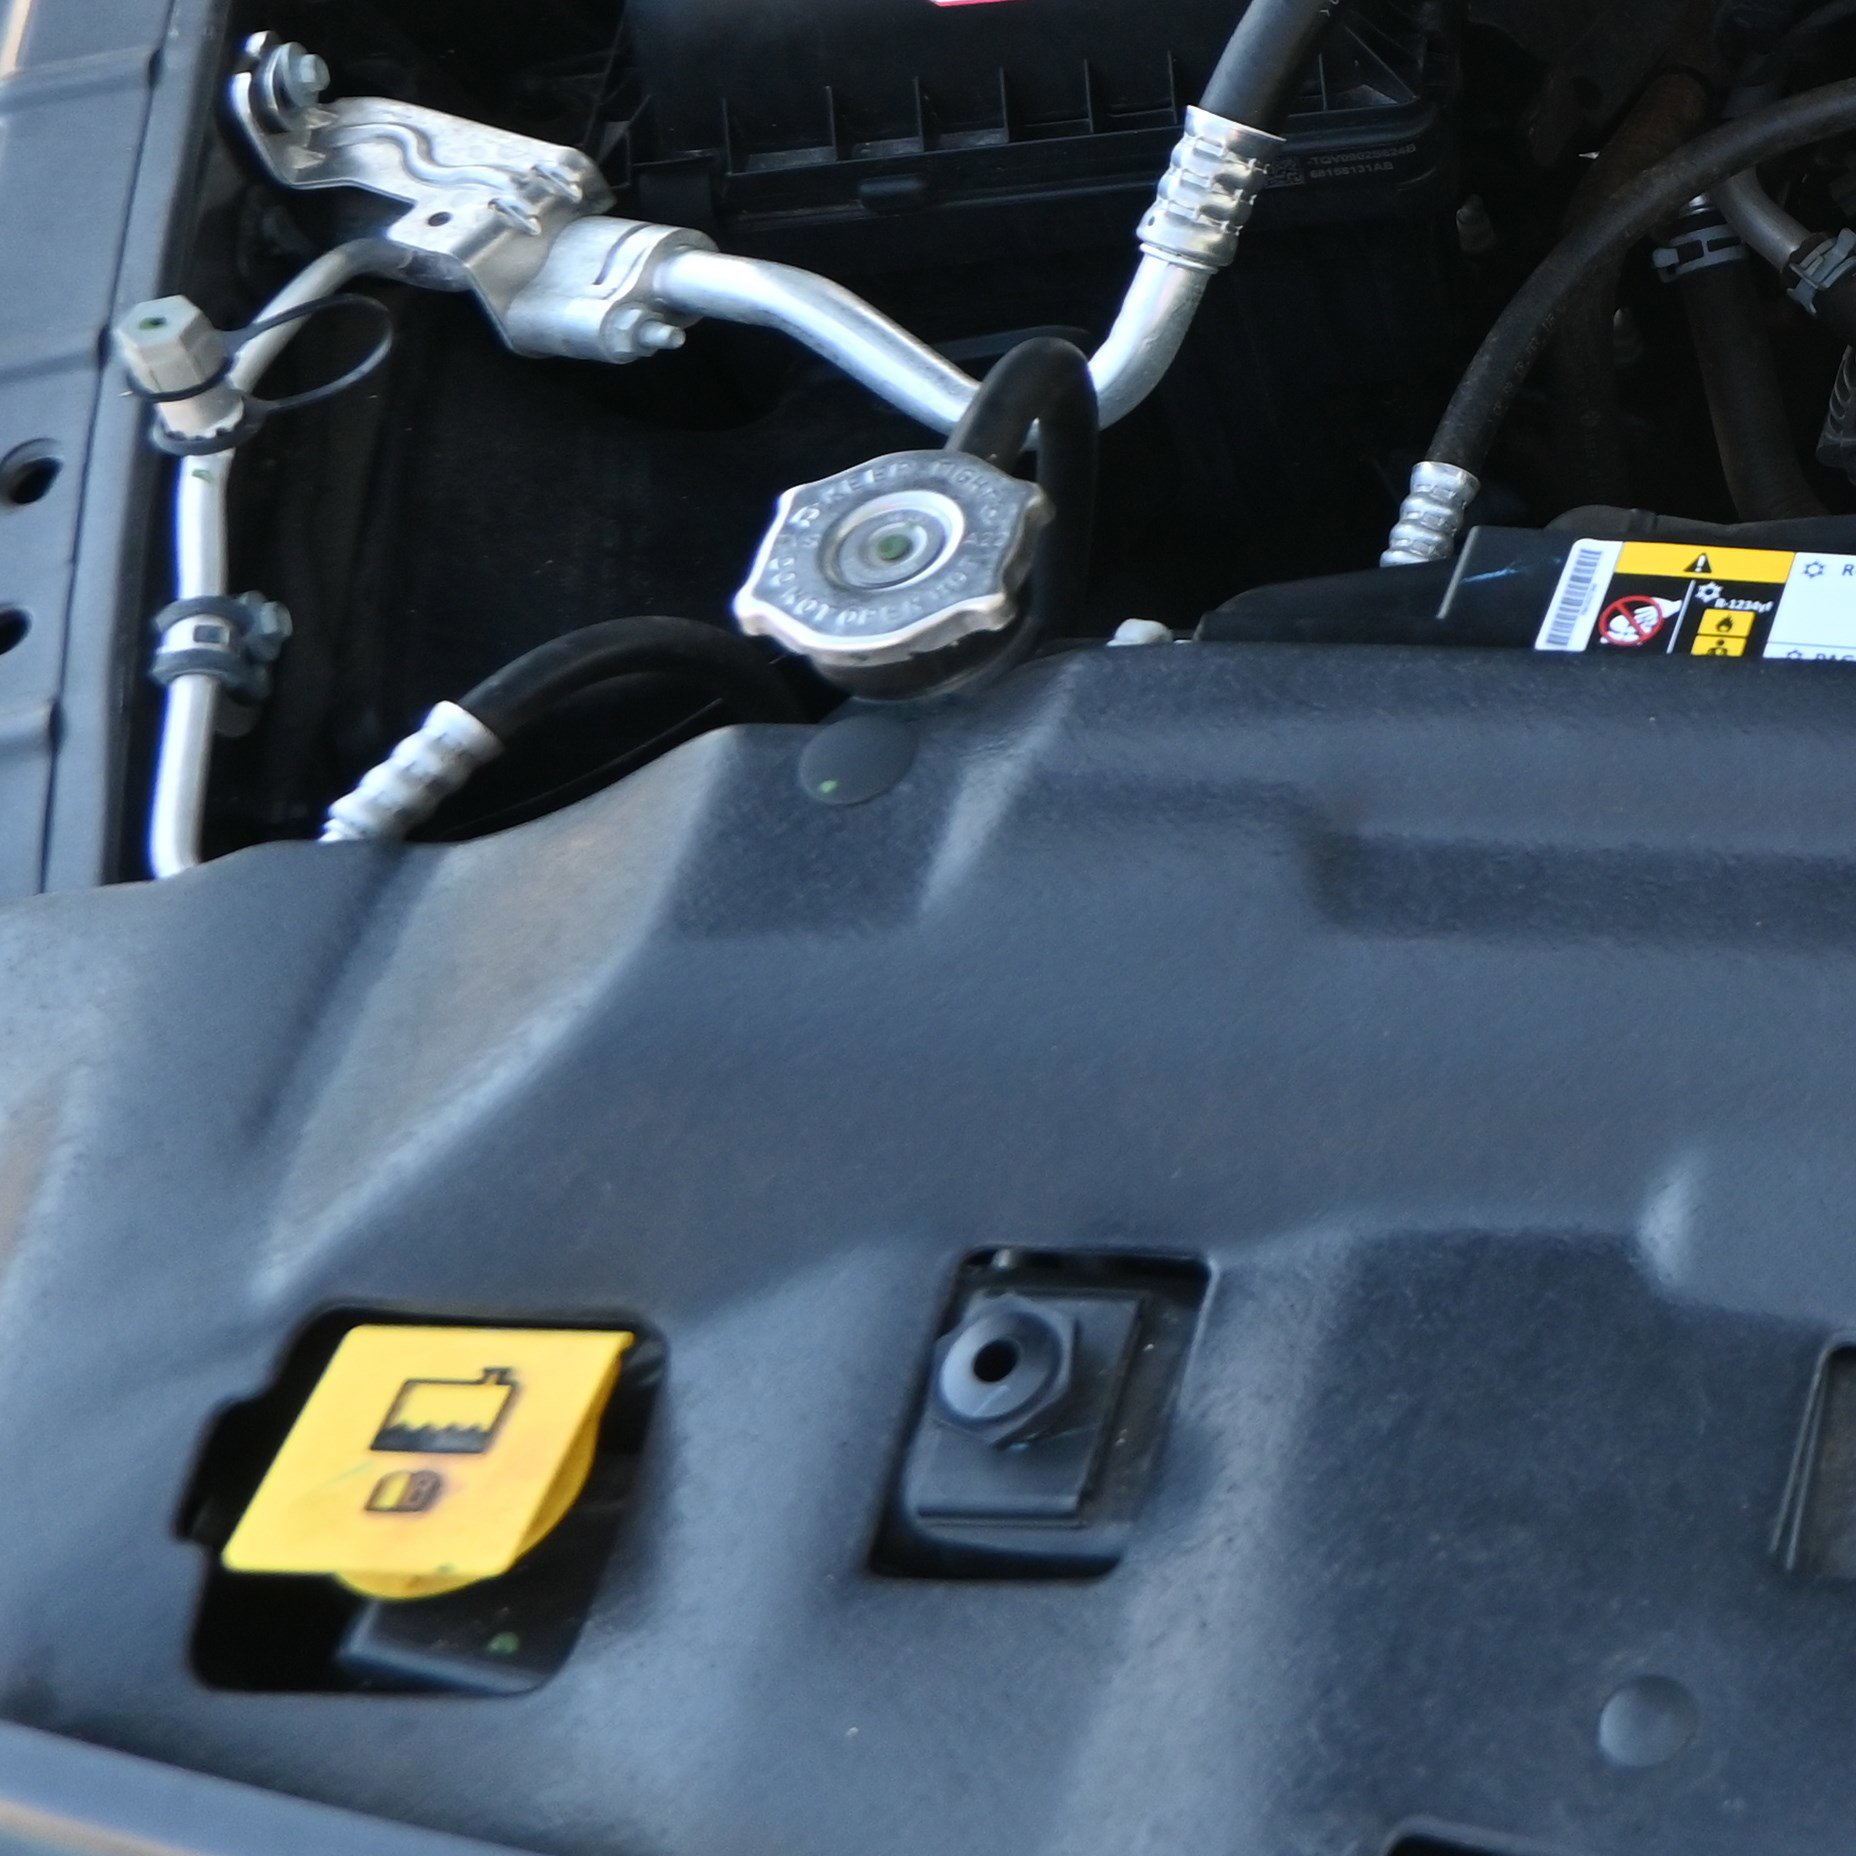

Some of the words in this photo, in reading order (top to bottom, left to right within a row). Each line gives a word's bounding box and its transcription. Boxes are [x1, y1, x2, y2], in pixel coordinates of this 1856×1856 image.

[822, 461, 911, 501] KEEP
[780, 592, 833, 623] NOT
[834, 596, 923, 630] OPEN
[1714, 597, 1774, 614] R-1234yf
